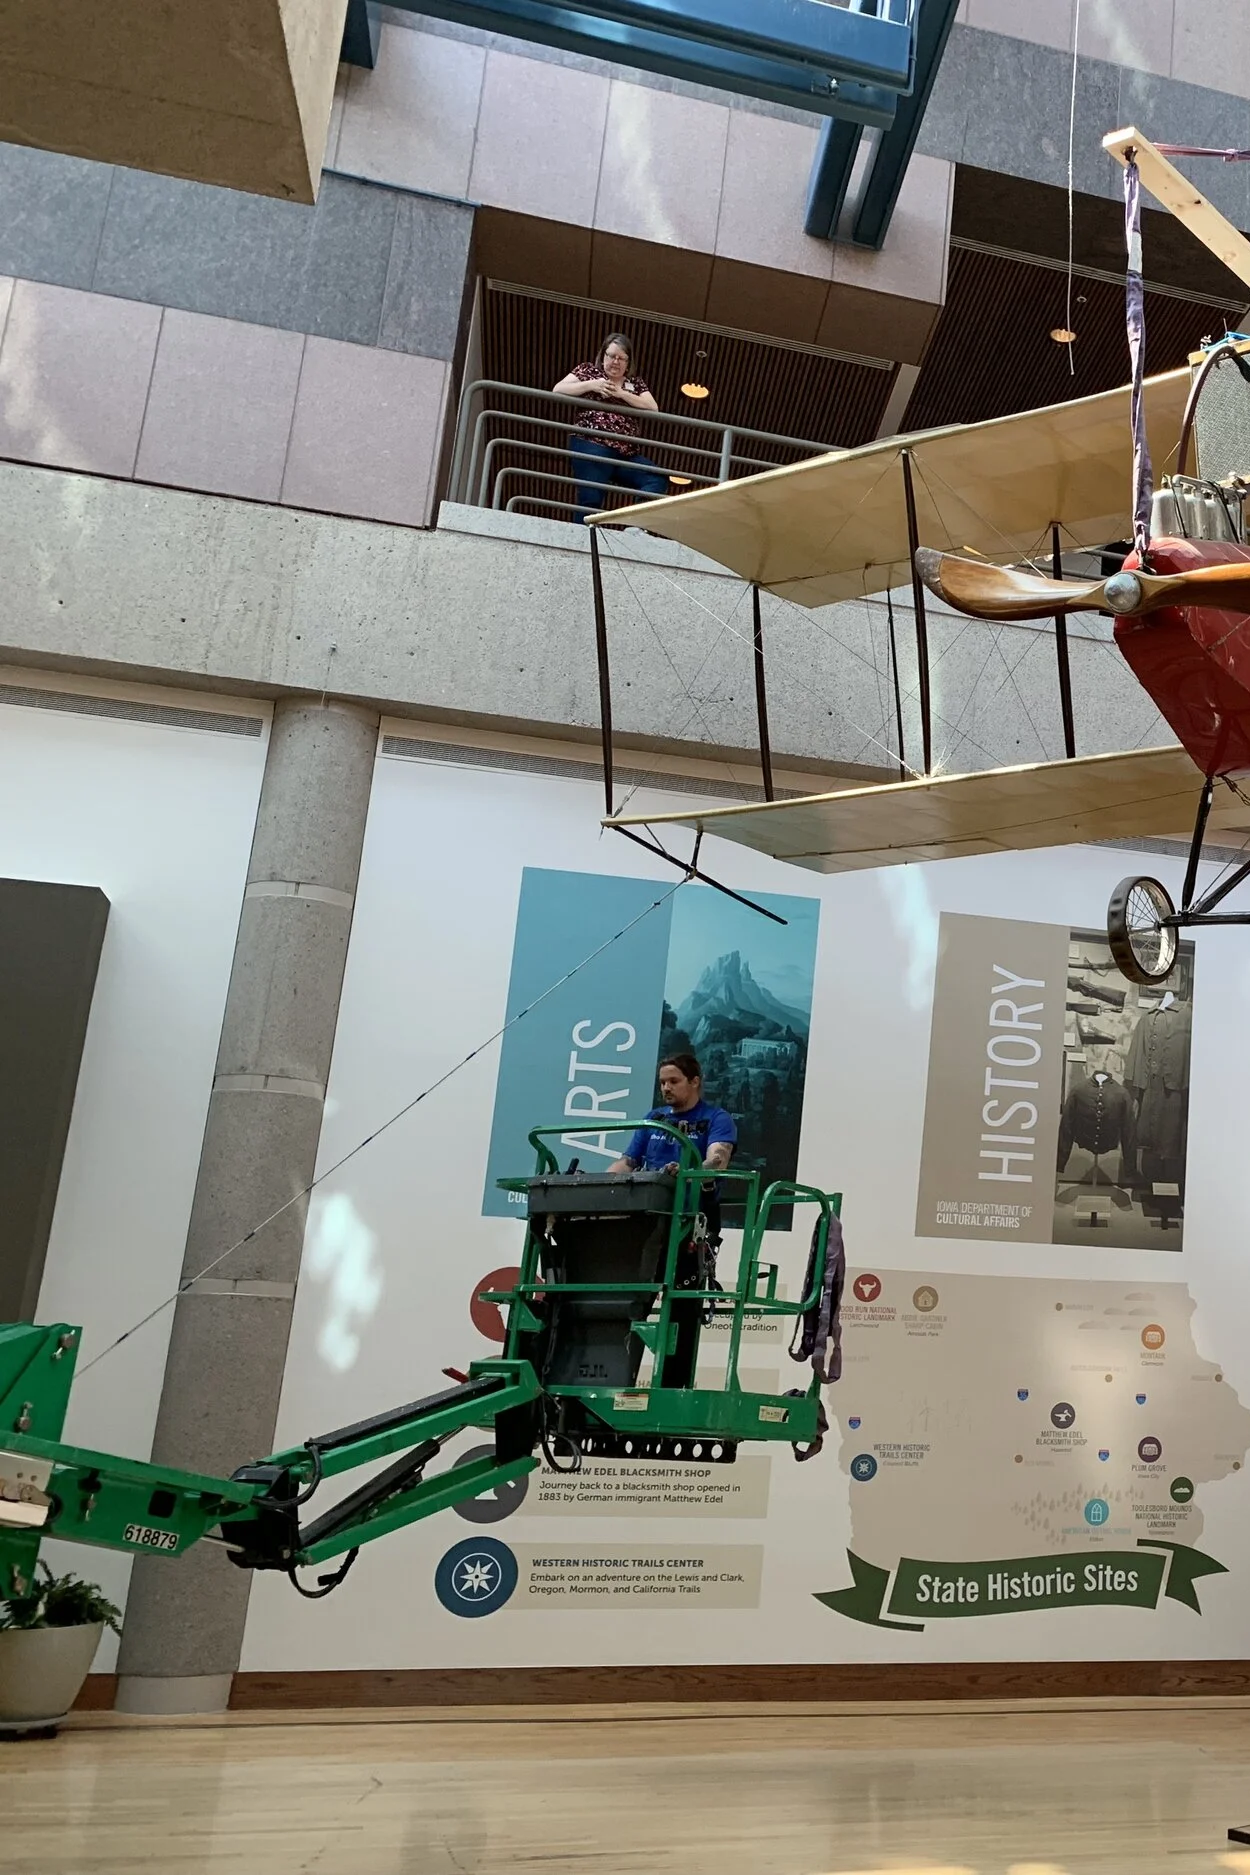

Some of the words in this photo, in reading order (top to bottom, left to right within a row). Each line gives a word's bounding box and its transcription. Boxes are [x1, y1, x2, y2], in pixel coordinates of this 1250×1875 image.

[977, 963, 1046, 1183] HISTORY
[561, 1019, 637, 1160] ARTS
[937, 1200, 958, 1212] IOWA
[961, 1202, 1020, 1216] DEPARTMENT
[1022, 1206, 1033, 1217] OF
[936, 1212, 982, 1226] CULTURAL
[983, 1215, 1020, 1228] AFFAIRS
[840, 1313, 861, 1321] STORIC
[704, 1322, 735, 1331] Oneot
[741, 1323, 778, 1332] radition
[594, 1467, 618, 1476] EDEL
[620, 1468, 683, 1477] BLACKSMITH
[684, 1469, 711, 1478] SHOP
[539, 1480, 577, 1491] Journey
[579, 1482, 601, 1490] back
[603, 1482, 613, 1490] to
[622, 1482, 671, 1491] blacksmith
[673, 1483, 695, 1492] shop
[697, 1484, 730, 1493] opened
[732, 1484, 741, 1492] in
[538, 1493, 561, 1501] 1883
[563, 1493, 575, 1503] by
[576, 1493, 613, 1502] German
[615, 1494, 661, 1504] immigrant
[663, 1494, 702, 1503] Matthew
[704, 1495, 724, 1503] Edel
[124, 1525, 178, 1550] 618879
[532, 1559, 579, 1567] WESTERN
[581, 1559, 629, 1567] HISTORIC
[631, 1559, 665, 1568] TRAILS
[666, 1559, 704, 1568] CENTER
[530, 1573, 565, 1582] Embark
[595, 1574, 641, 1582] adventure
[657, 1574, 672, 1582] the
[674, 1574, 699, 1582] Lewis
[701, 1574, 718, 1582] and
[720, 1573, 745, 1583] Clark,
[916, 1574, 979, 1603] State
[987, 1567, 1076, 1601] Historic
[1084, 1564, 1139, 1592] Sites
[529, 1585, 566, 1595] Oregon,
[569, 1585, 611, 1594] Mormon,
[613, 1585, 630, 1594] and
[632, 1585, 676, 1594] California
[678, 1585, 701, 1594] Trails
